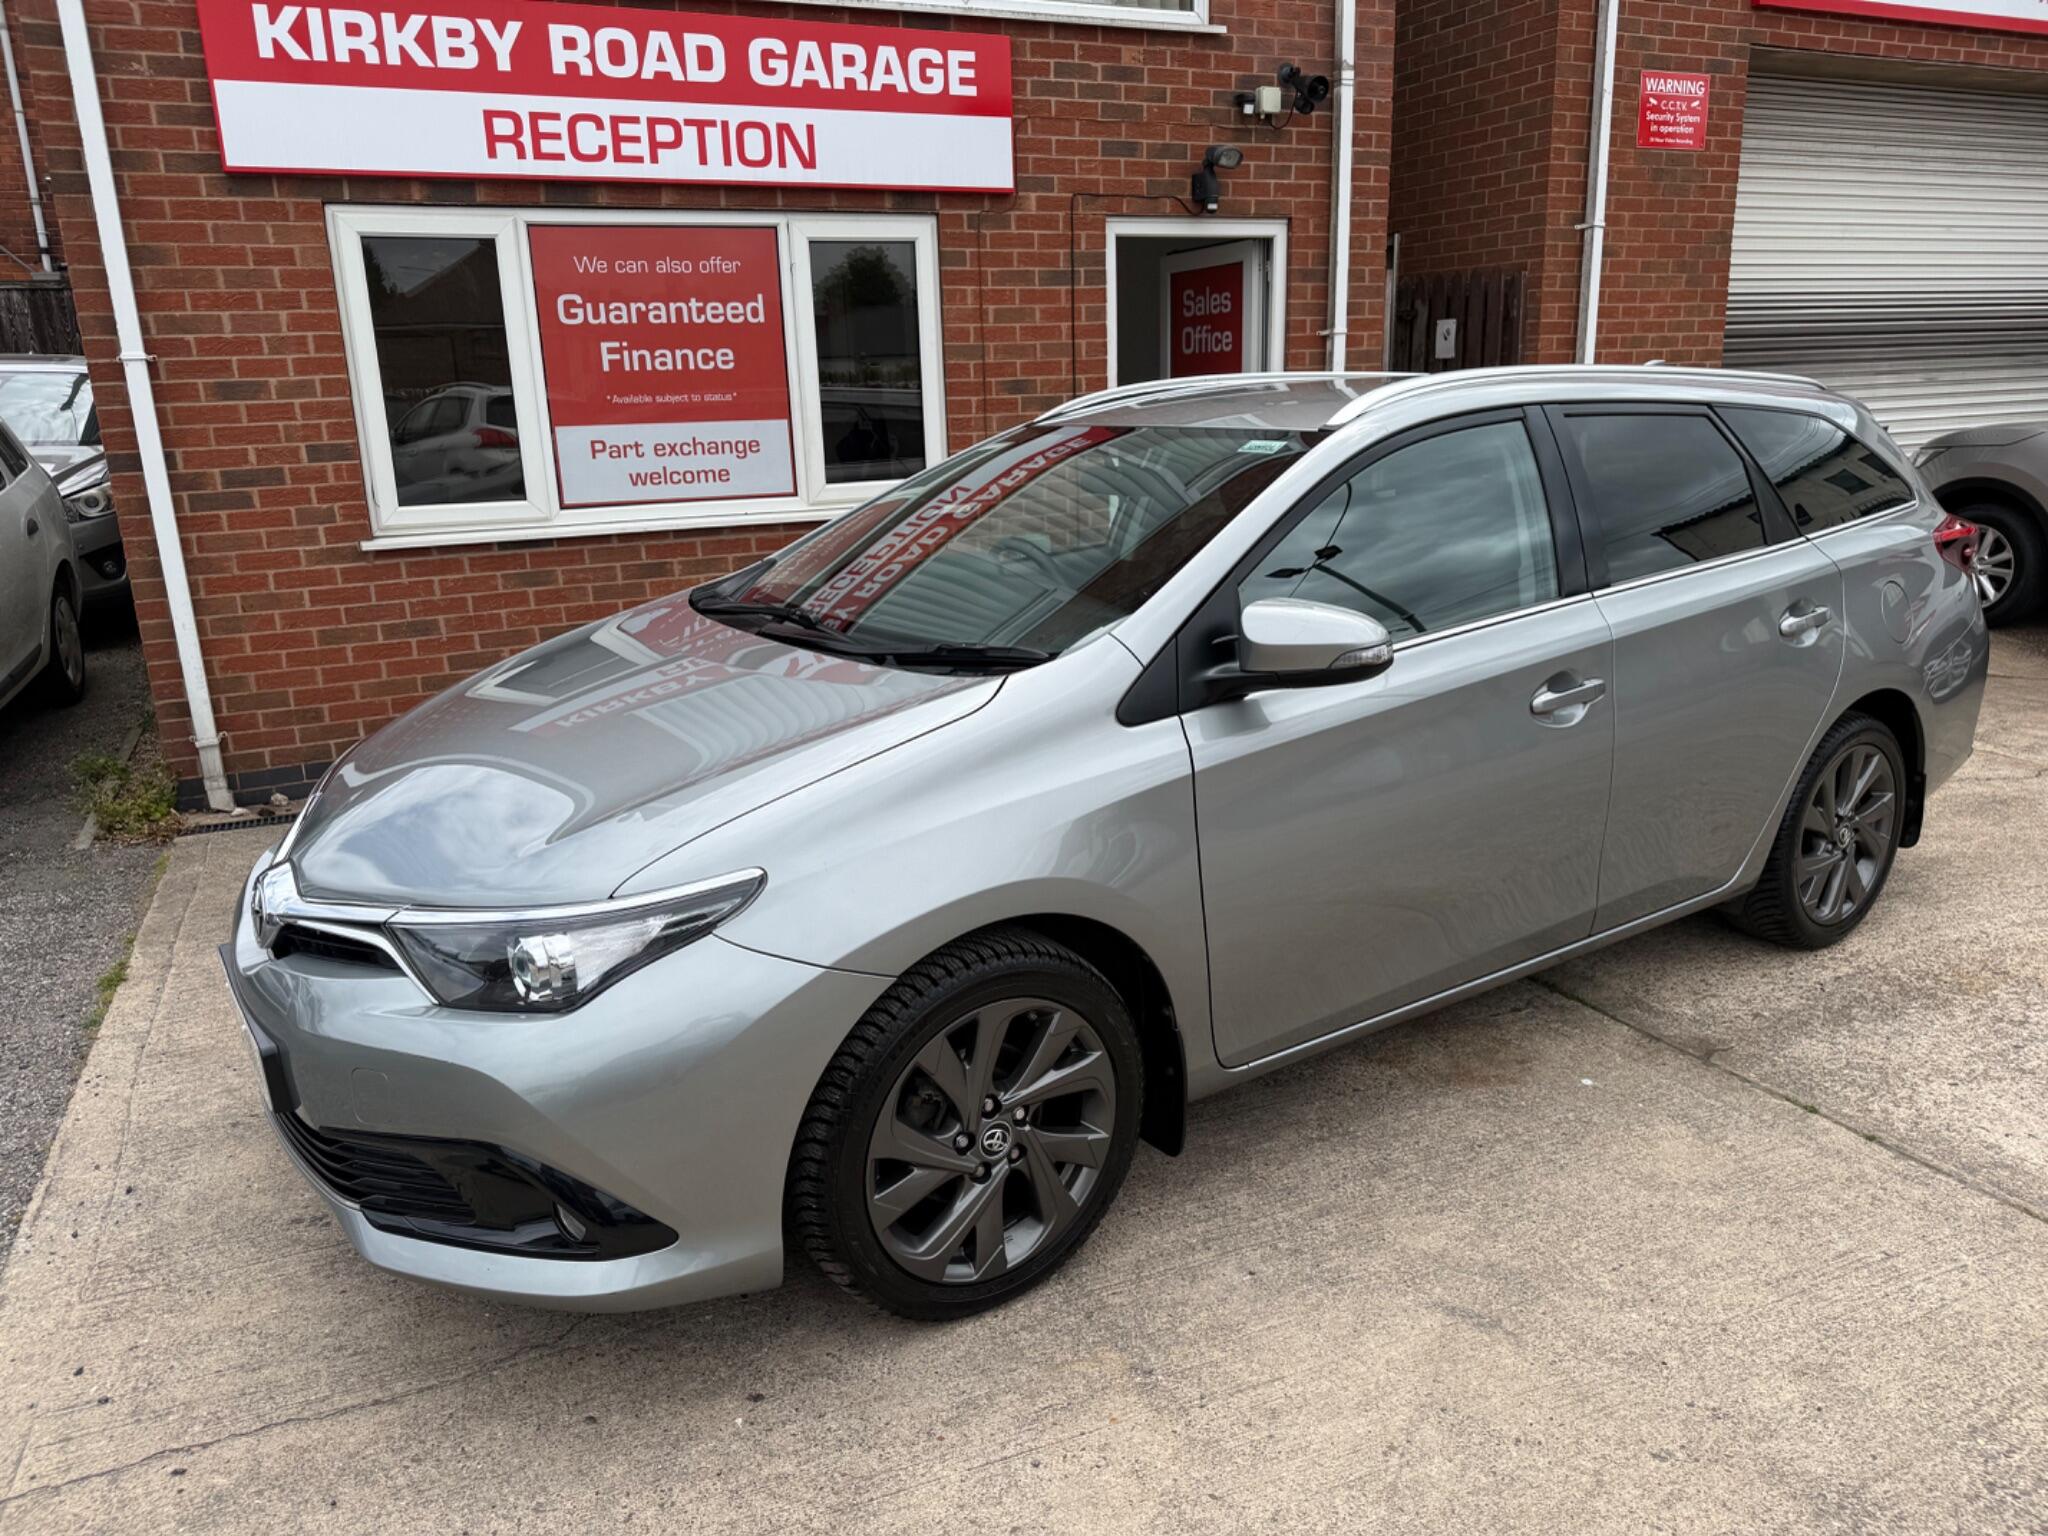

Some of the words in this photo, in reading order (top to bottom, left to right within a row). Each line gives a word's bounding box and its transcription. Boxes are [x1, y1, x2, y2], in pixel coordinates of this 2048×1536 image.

[251, 3, 522, 72] KIRKBY
[549, 25, 726, 83] ROAD
[748, 37, 978, 97] GARAGE
[1645, 77, 1705, 94] WARNING
[1646, 111, 1674, 123] Security
[1676, 113, 1701, 125] System
[1650, 123, 1658, 132] in
[1659, 124, 1695, 134] operation
[483, 109, 817, 170] RECEPTION
[573, 256, 608, 274] We
[615, 258, 649, 274] can
[656, 256, 692, 274] also
[699, 256, 741, 274] offer
[556, 293, 766, 325] Guaranteed
[1182, 285, 1232, 317] Sales
[1182, 324, 1233, 354] Office
[600, 341, 736, 372] Finance
[655, 393, 688, 405] subject
[691, 393, 701, 402] to
[590, 439, 645, 460] Part
[653, 437, 761, 460] exchange
[628, 466, 731, 487] welcome
